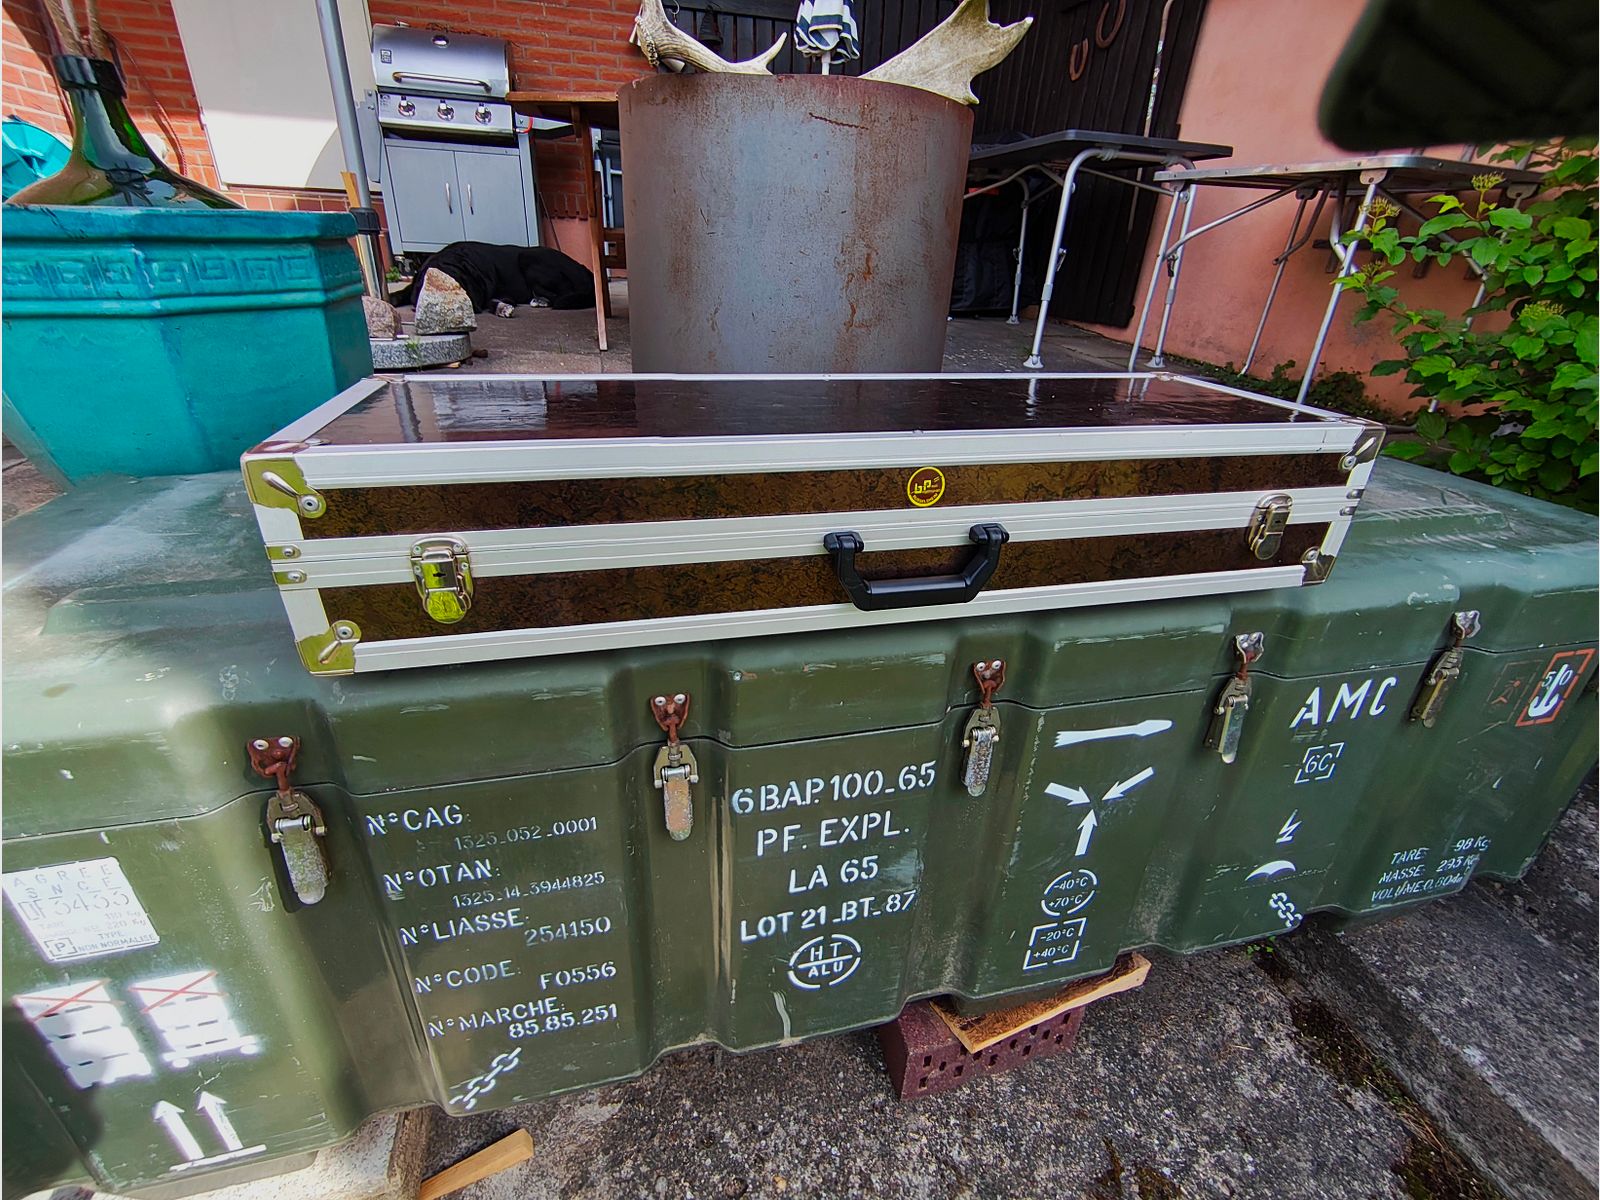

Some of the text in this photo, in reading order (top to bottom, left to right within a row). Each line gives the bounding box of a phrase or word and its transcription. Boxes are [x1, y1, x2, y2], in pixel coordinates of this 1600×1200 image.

[1289, 677, 1398, 728] AMC
[1305, 753, 1333, 773] 6C
[757, 810, 910, 857] PF. EXPL.
[789, 855, 880, 894] LA 65
[525, 916, 612, 947] 254150
[740, 911, 794, 943] LOT
[55, 942, 66, 952] P
[808, 962, 844, 979] ALU
[508, 1003, 618, 1039] 85.85.251
